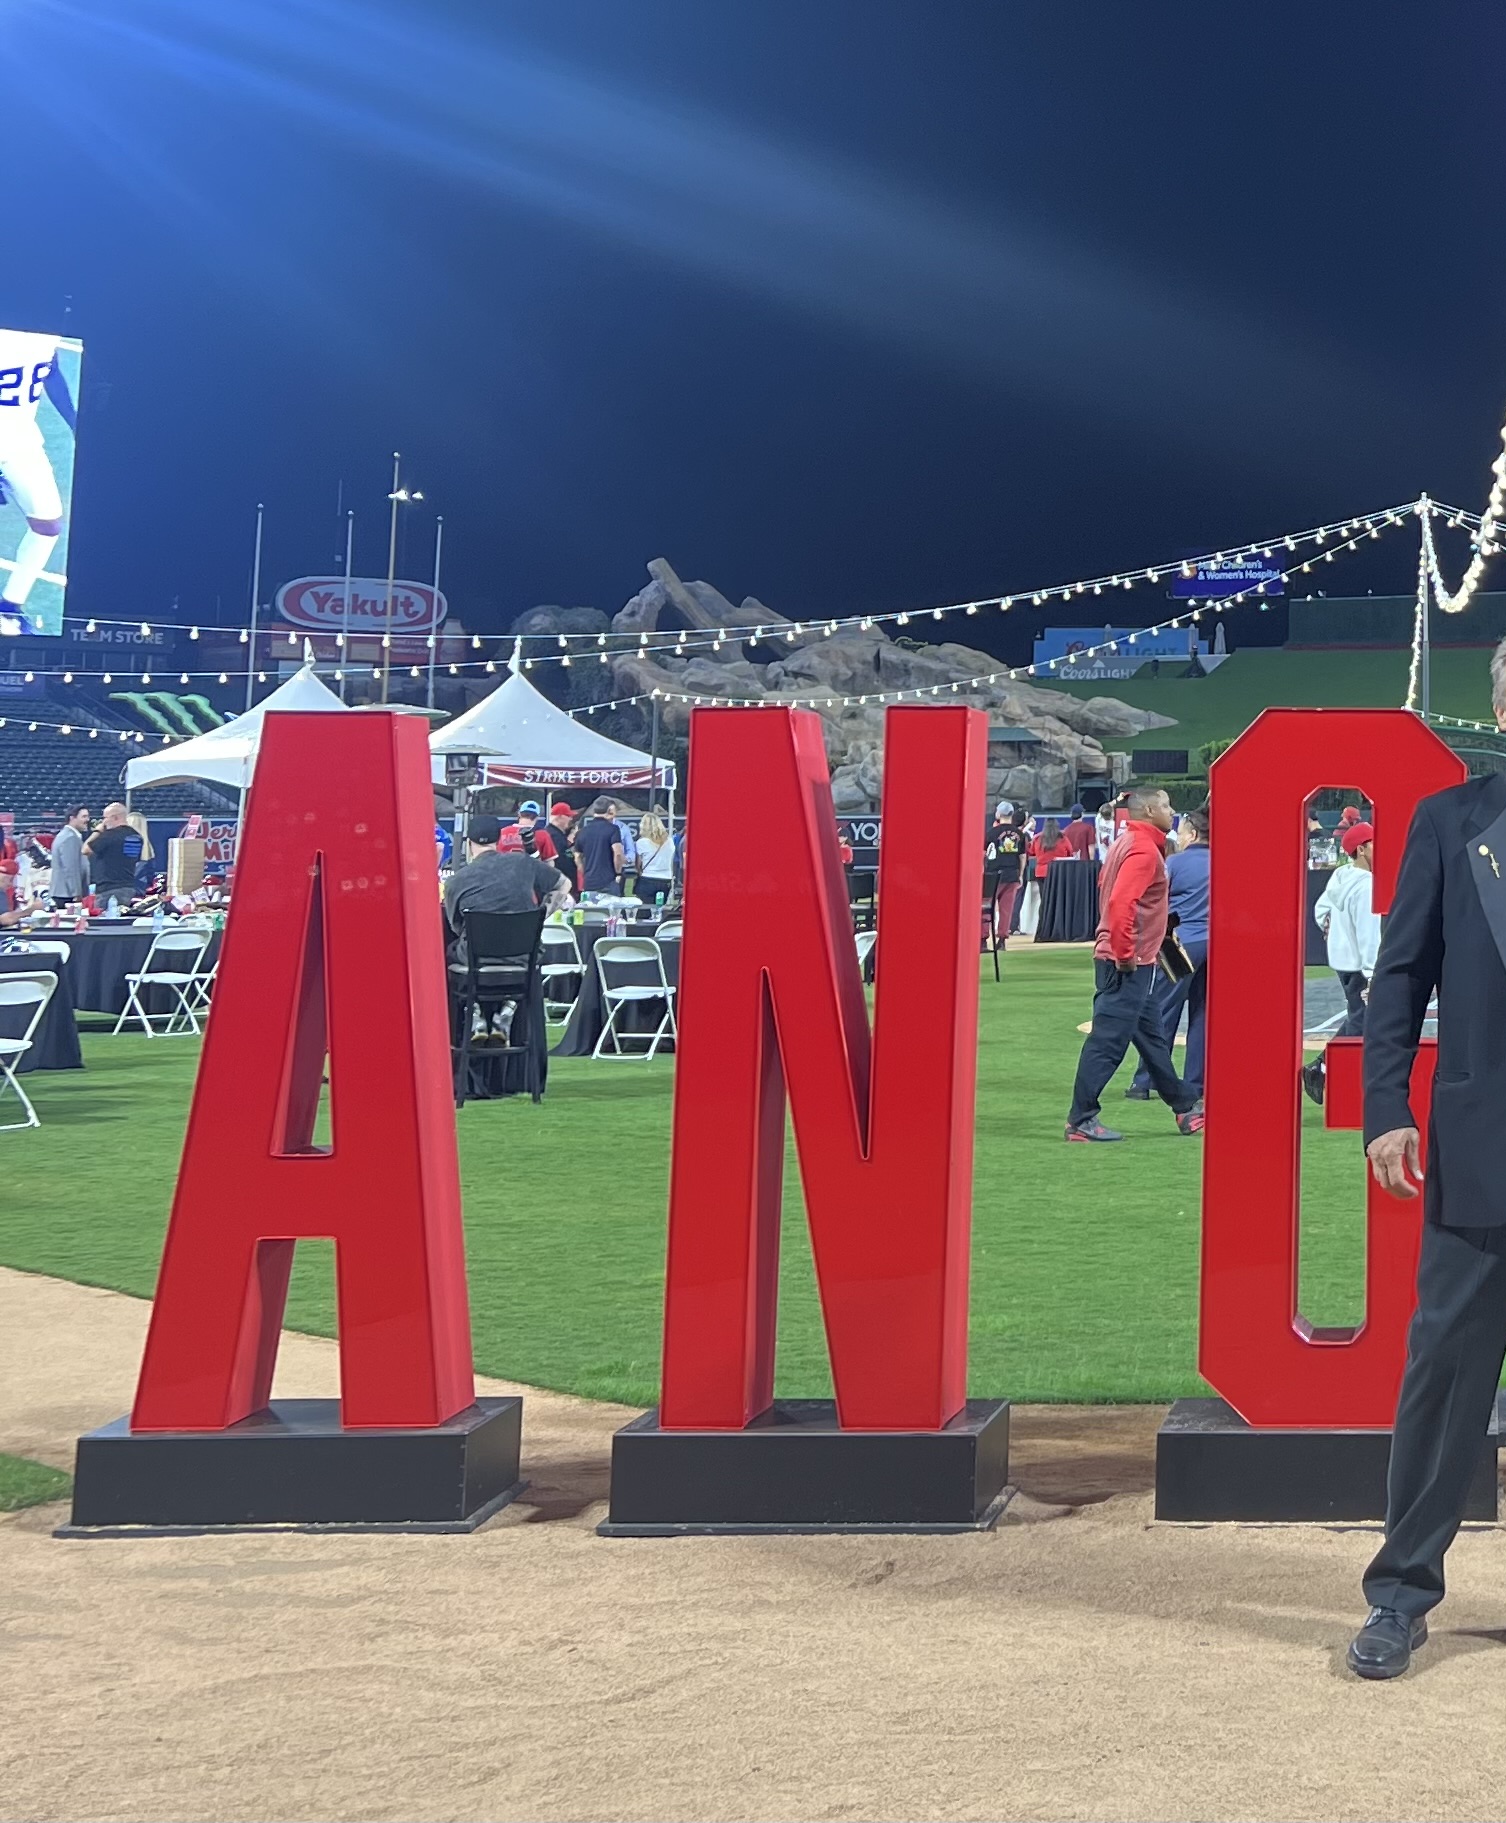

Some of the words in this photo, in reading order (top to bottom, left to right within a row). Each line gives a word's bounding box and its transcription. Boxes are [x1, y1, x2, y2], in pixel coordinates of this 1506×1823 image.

[309, 591, 420, 619] Yakult
[70, 628, 112, 643] TEM
[115, 630, 164, 645] STORE
[1060, 665, 1100, 680] Coors
[524, 769, 576, 784] STRIKE
[580, 769, 629, 785] FORCE
